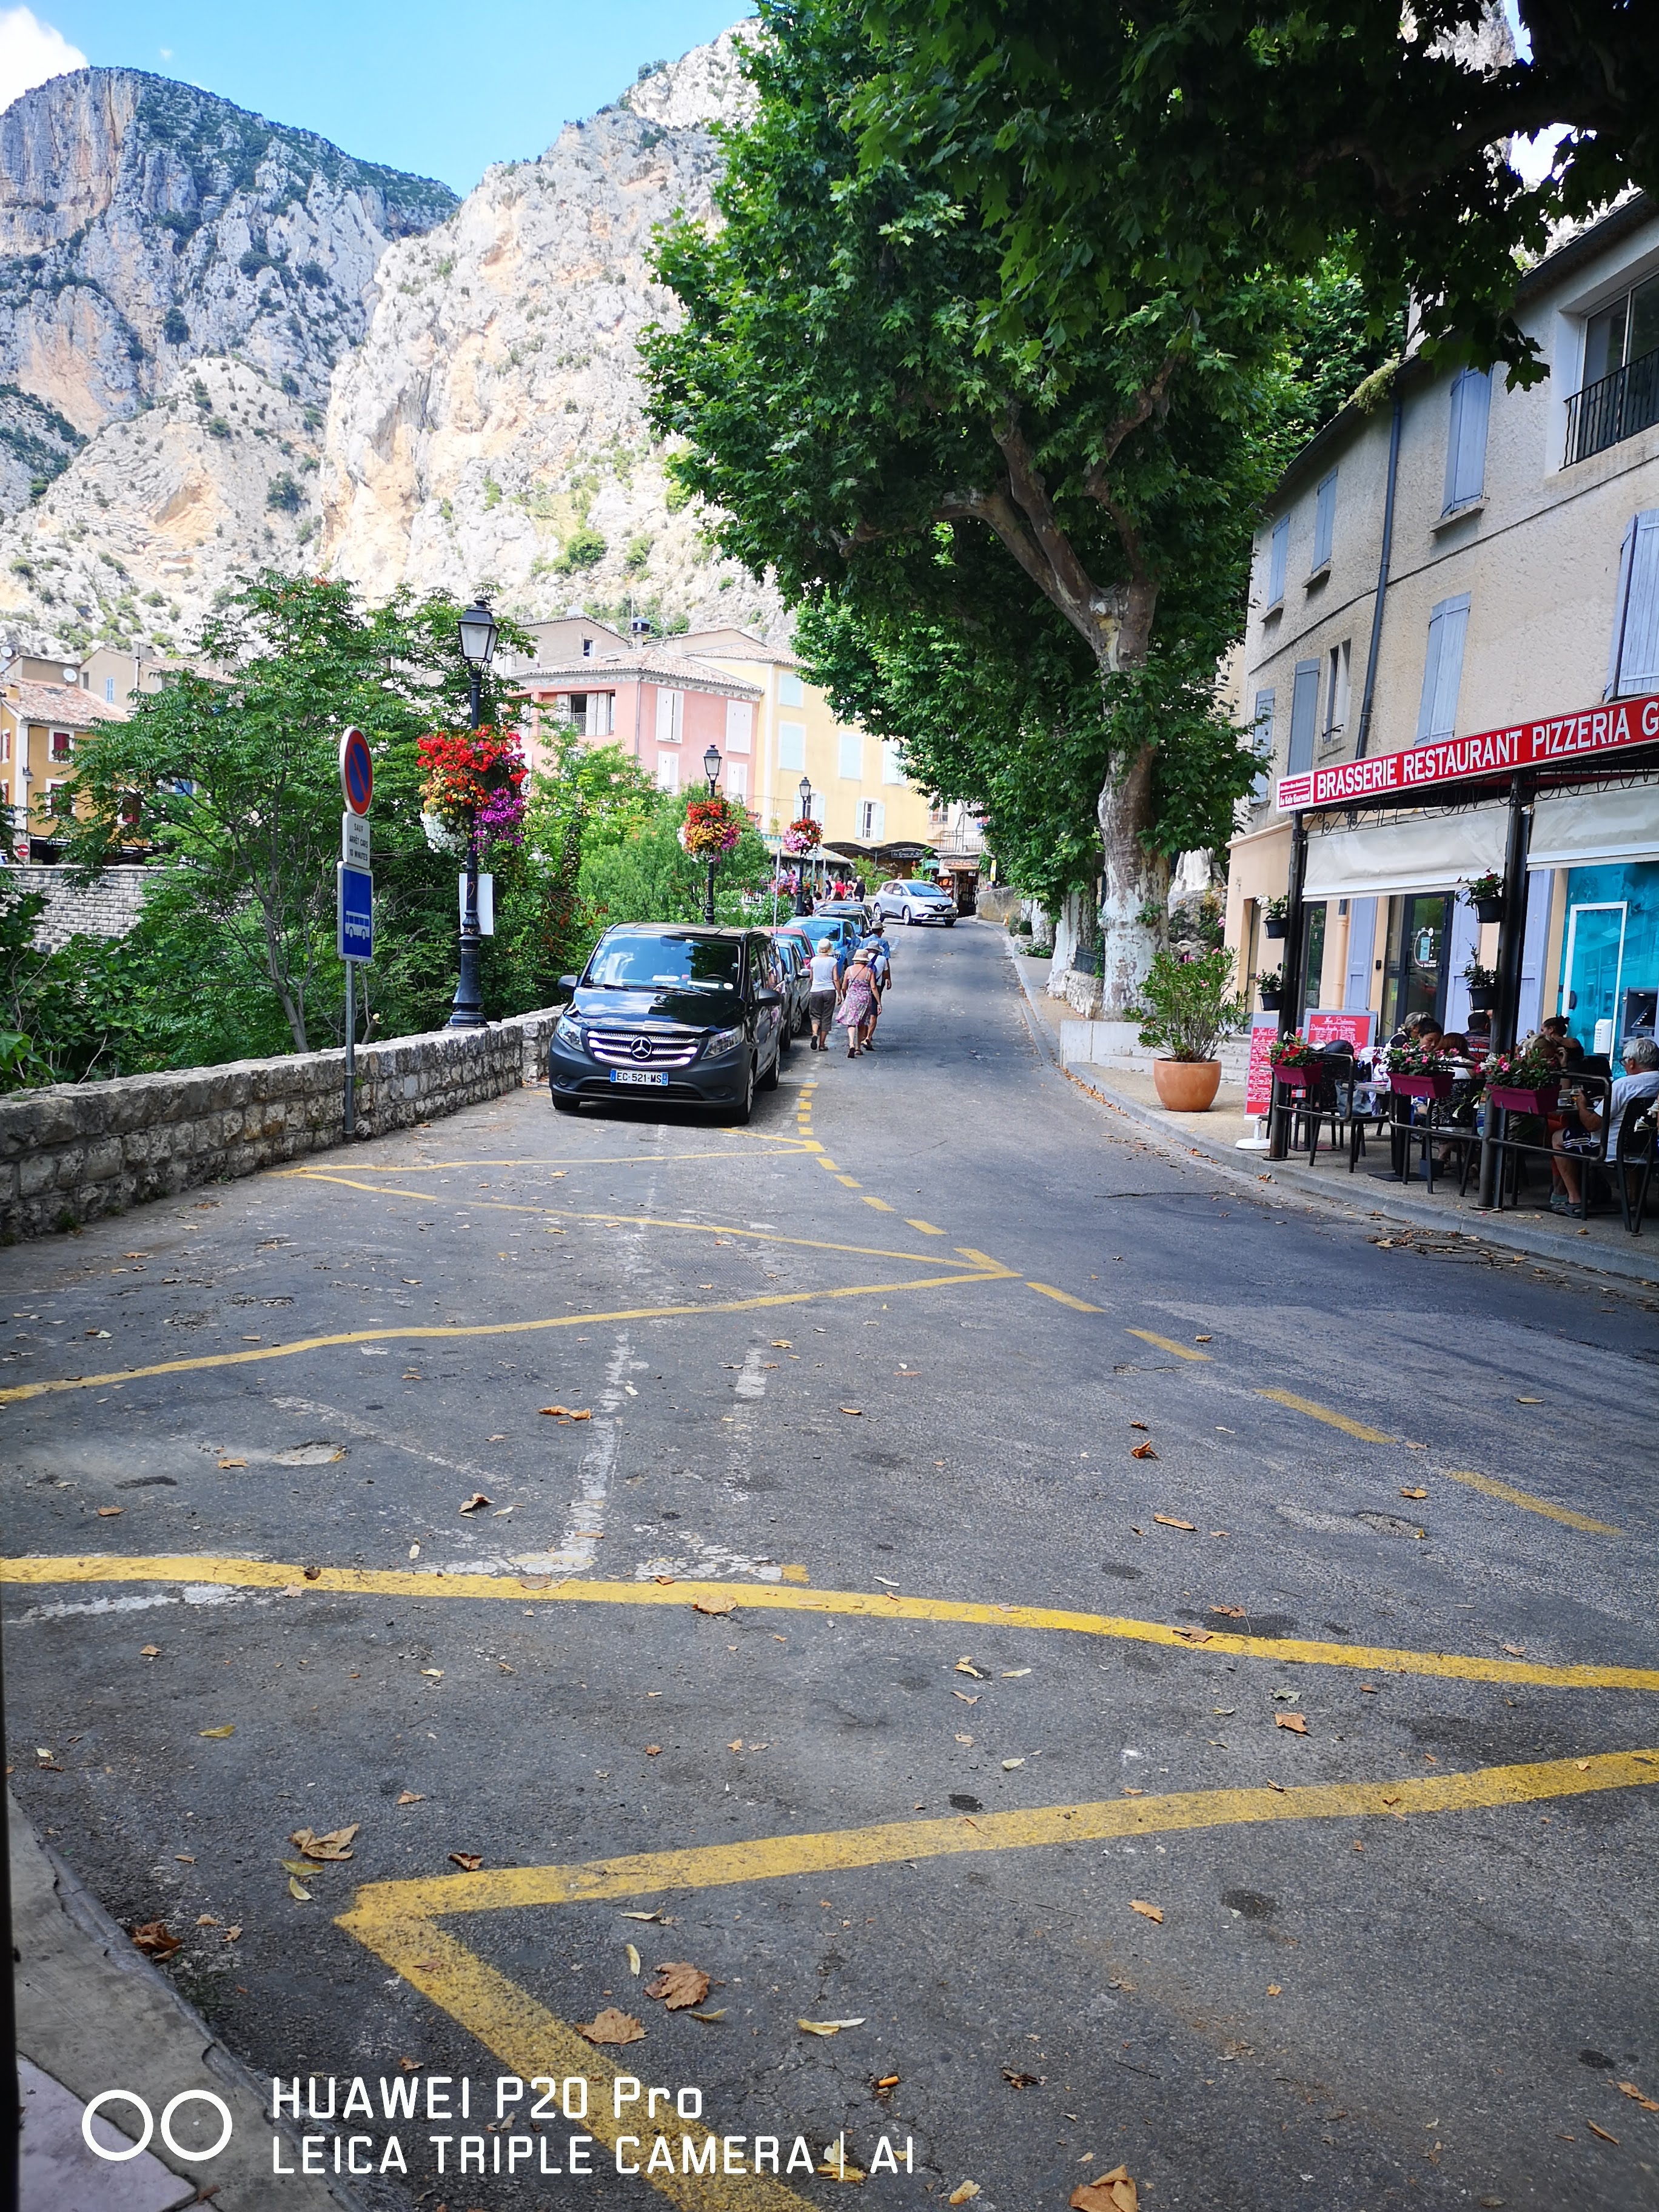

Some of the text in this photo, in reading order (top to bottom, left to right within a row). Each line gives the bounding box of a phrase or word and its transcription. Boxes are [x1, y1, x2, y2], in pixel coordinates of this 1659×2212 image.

[1317, 757, 1397, 800] BRASSERIE
[1403, 730, 1523, 783] RESTAURANT
[1532, 706, 1631, 756] PIZZERIA
[354, 823, 363, 833] SAUF
[354, 850, 368, 861] MINUTES
[617, 1072, 662, 1083] EC-521-MS
